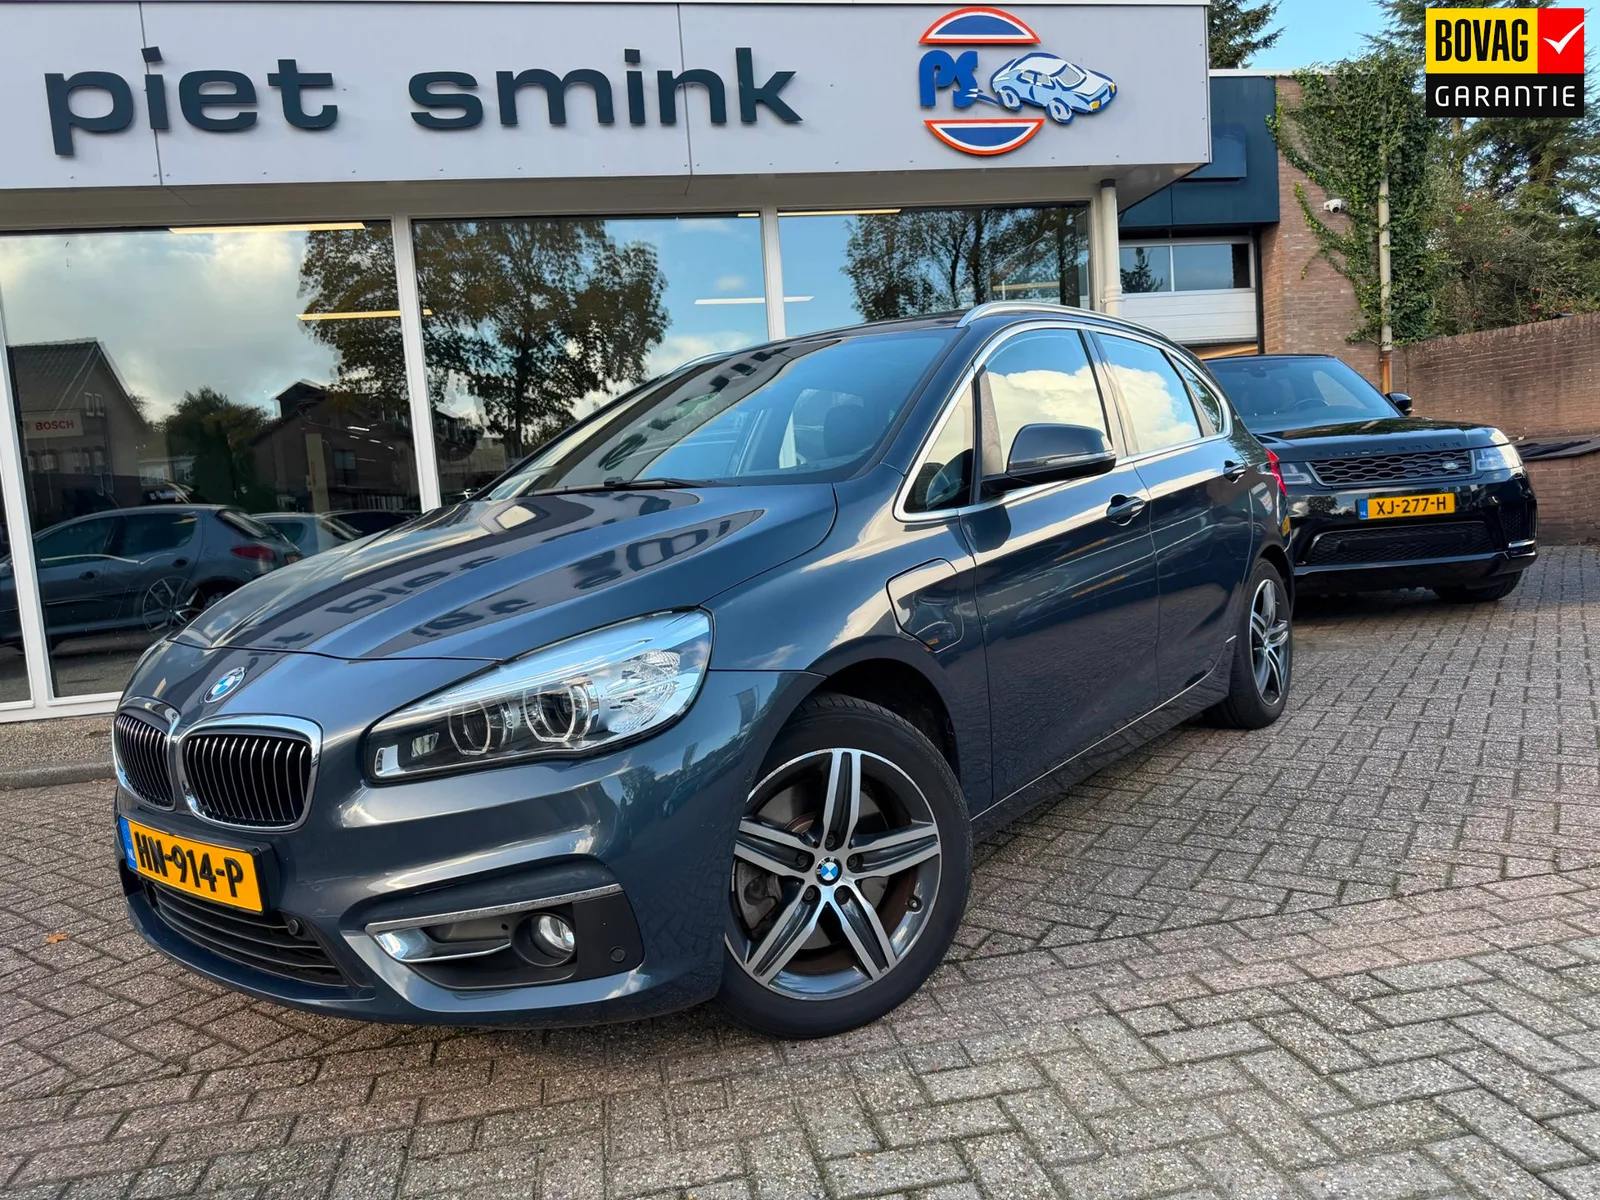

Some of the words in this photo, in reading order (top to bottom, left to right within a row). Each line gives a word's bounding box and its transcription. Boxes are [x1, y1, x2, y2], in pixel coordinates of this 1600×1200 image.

[43, 46, 339, 156] piet
[408, 47, 804, 130] smink
[35, 420, 75, 431] BOSCH
[1376, 496, 1447, 516] XJ-277-H
[134, 830, 244, 898] HN-914-P
